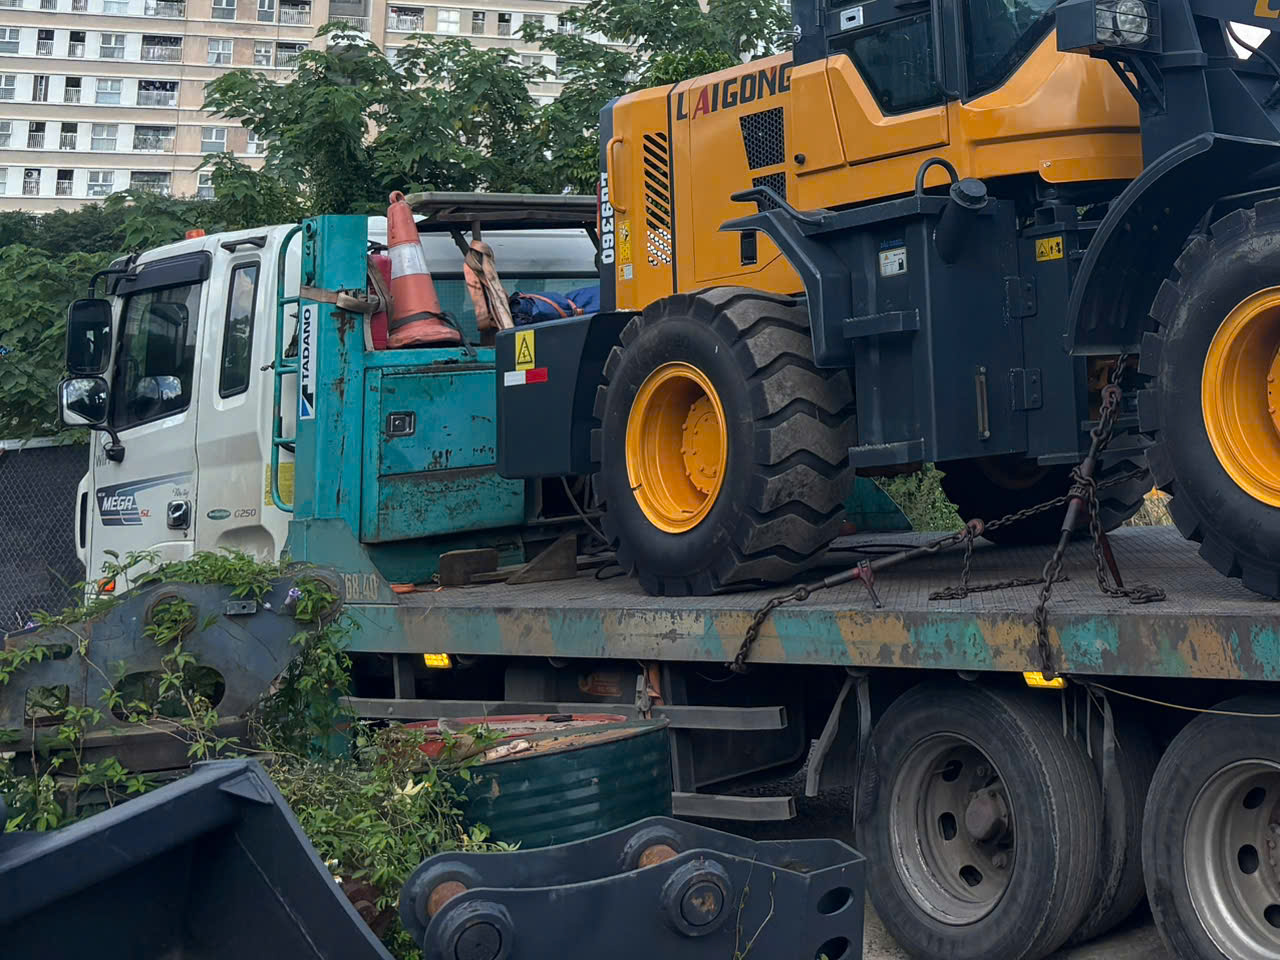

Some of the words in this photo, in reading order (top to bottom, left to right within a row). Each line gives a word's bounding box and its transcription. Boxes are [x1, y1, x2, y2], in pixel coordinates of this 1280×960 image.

[676, 61, 793, 121] LAIGONG
[302, 308, 311, 382] TADANO
[102, 495, 134, 511] MEGA
